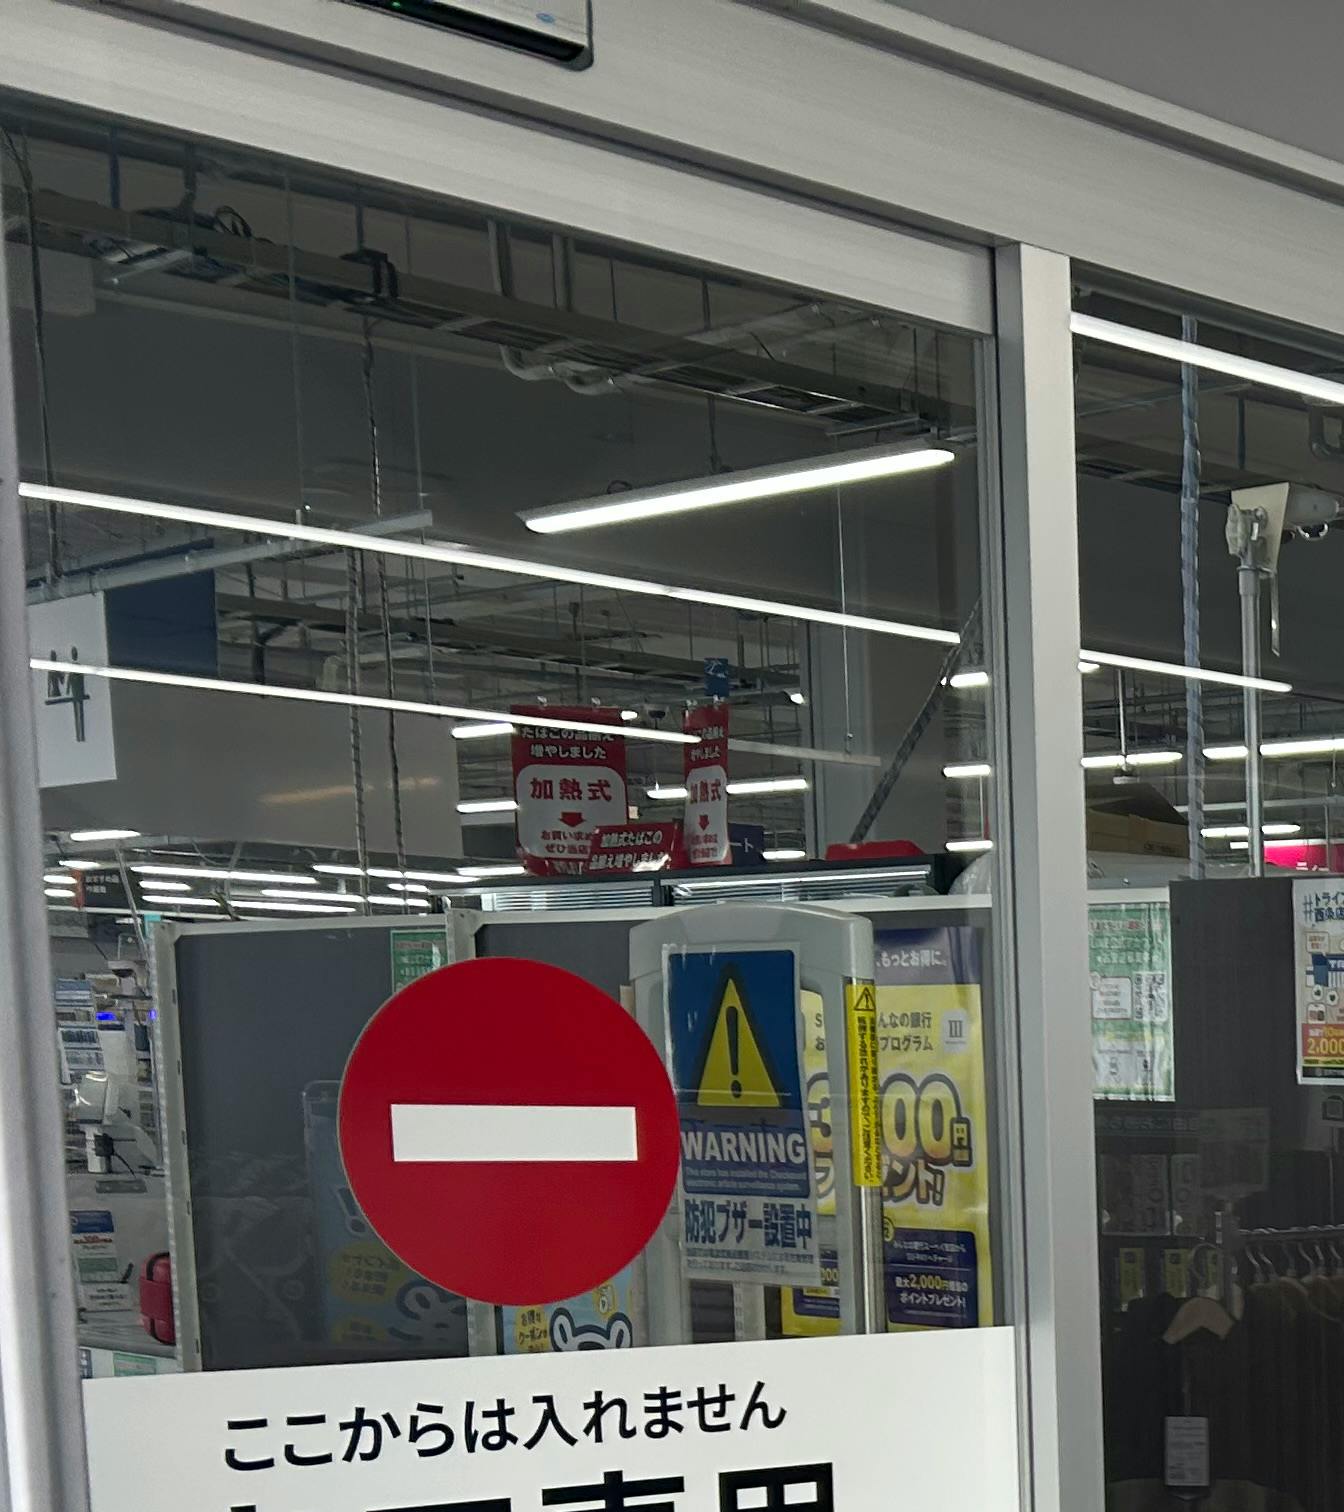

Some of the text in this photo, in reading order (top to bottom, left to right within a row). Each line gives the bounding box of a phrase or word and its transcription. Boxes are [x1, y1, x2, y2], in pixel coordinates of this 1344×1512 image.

[530, 744, 608, 760] 増やしました
[530, 777, 613, 802] 加熱式
[682, 1130, 807, 1164] WARNING
[685, 1199, 812, 1249] 防犯ブザー設置中
[223, 1381, 788, 1472] ここからは入れません
